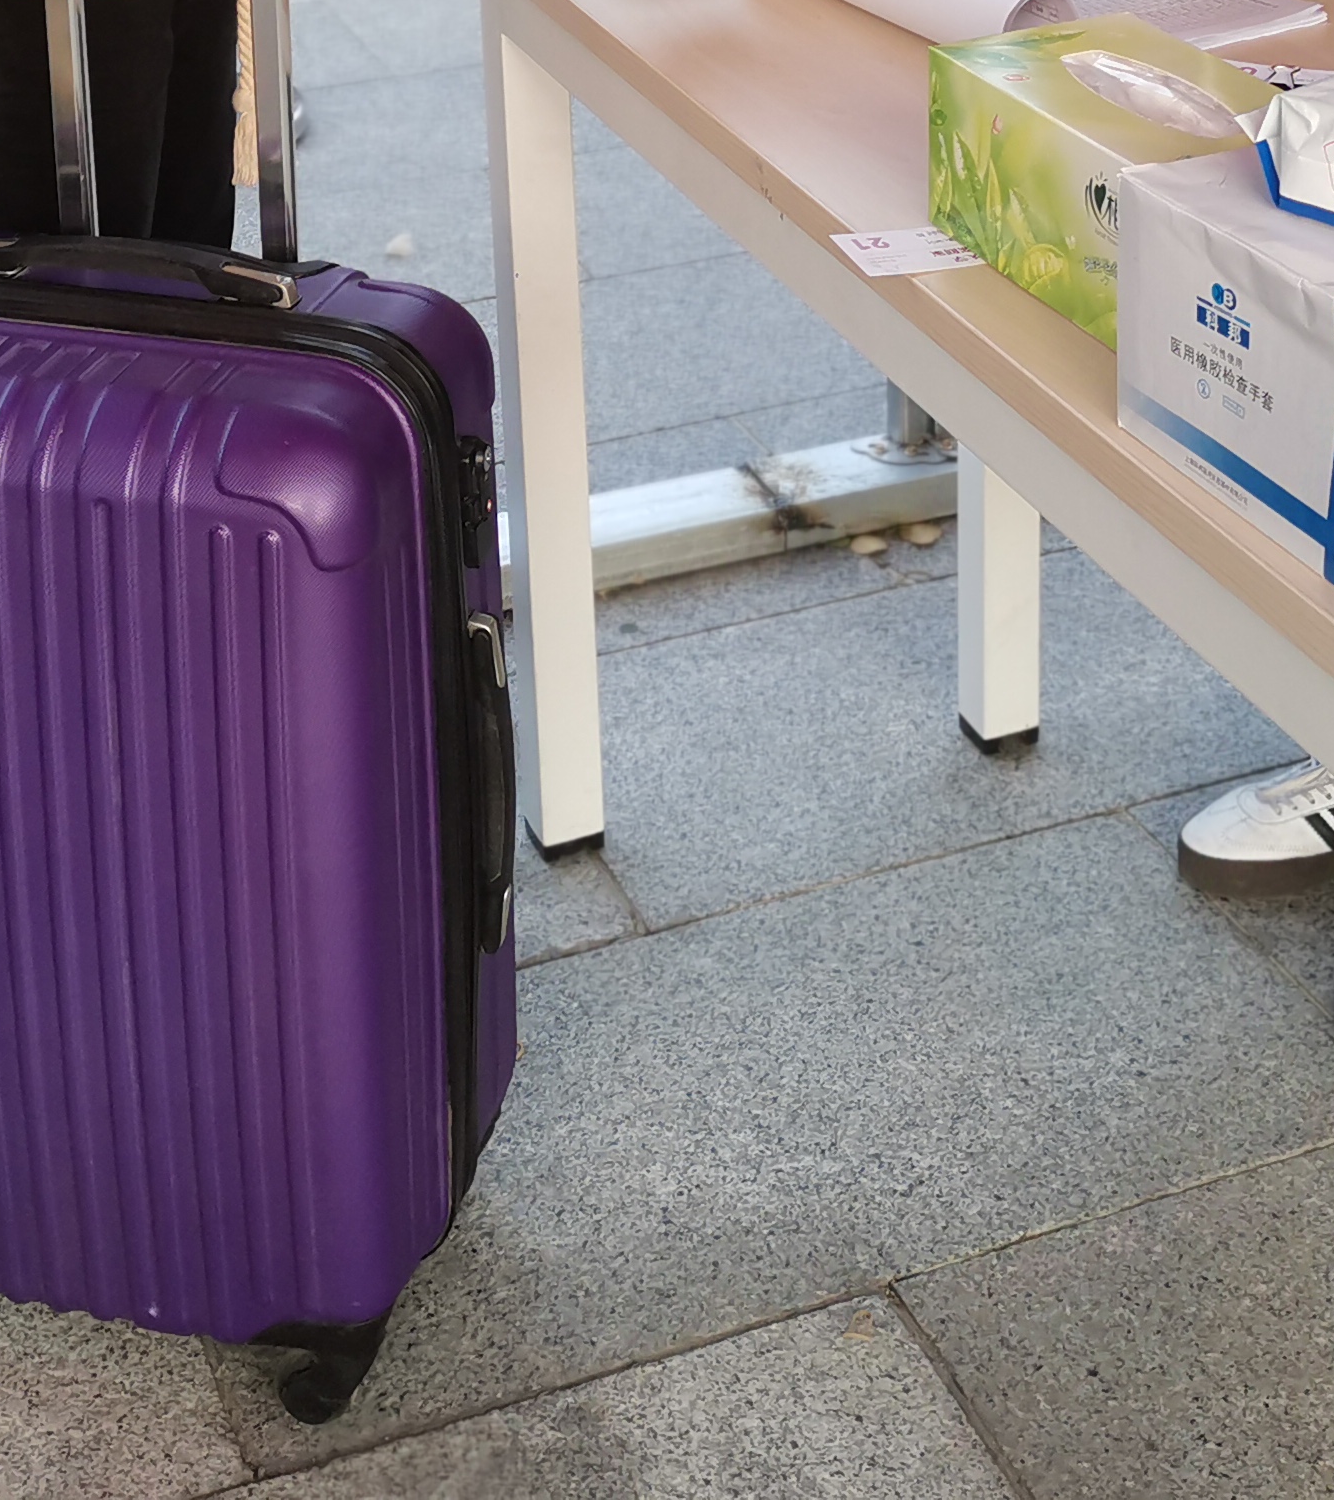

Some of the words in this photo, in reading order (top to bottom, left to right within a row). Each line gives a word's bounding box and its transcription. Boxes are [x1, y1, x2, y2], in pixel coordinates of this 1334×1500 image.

[1205, 309, 1242, 344] 科邦
[1171, 336, 1274, 413] 医用橡胶检查手套
